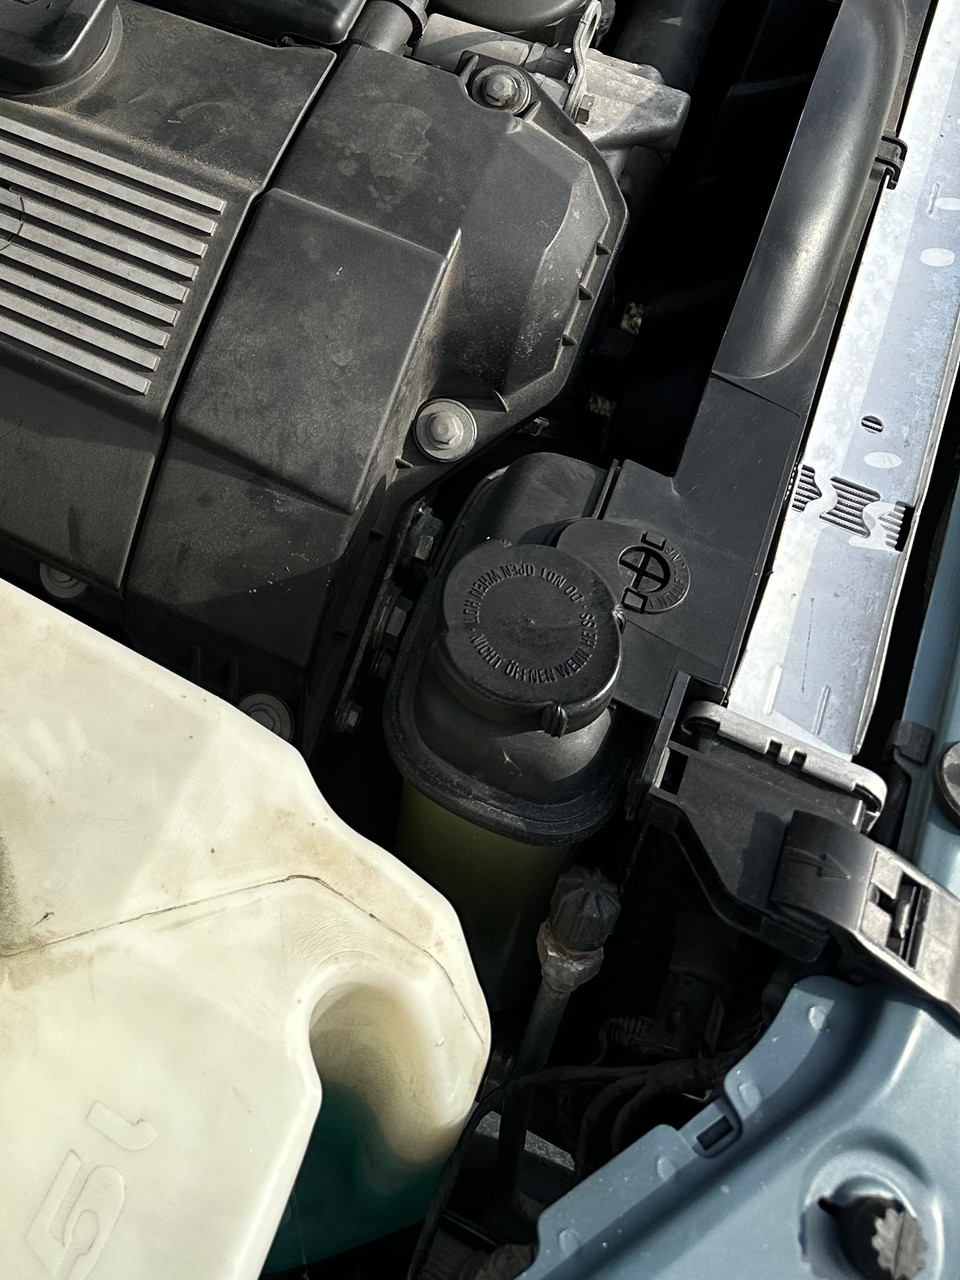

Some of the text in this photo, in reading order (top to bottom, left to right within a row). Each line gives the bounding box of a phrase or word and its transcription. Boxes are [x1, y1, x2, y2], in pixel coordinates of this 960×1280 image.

[462, 563, 585, 624] DO NOT OPEN WHEN HOT
[468, 632, 503, 670] NICHT
